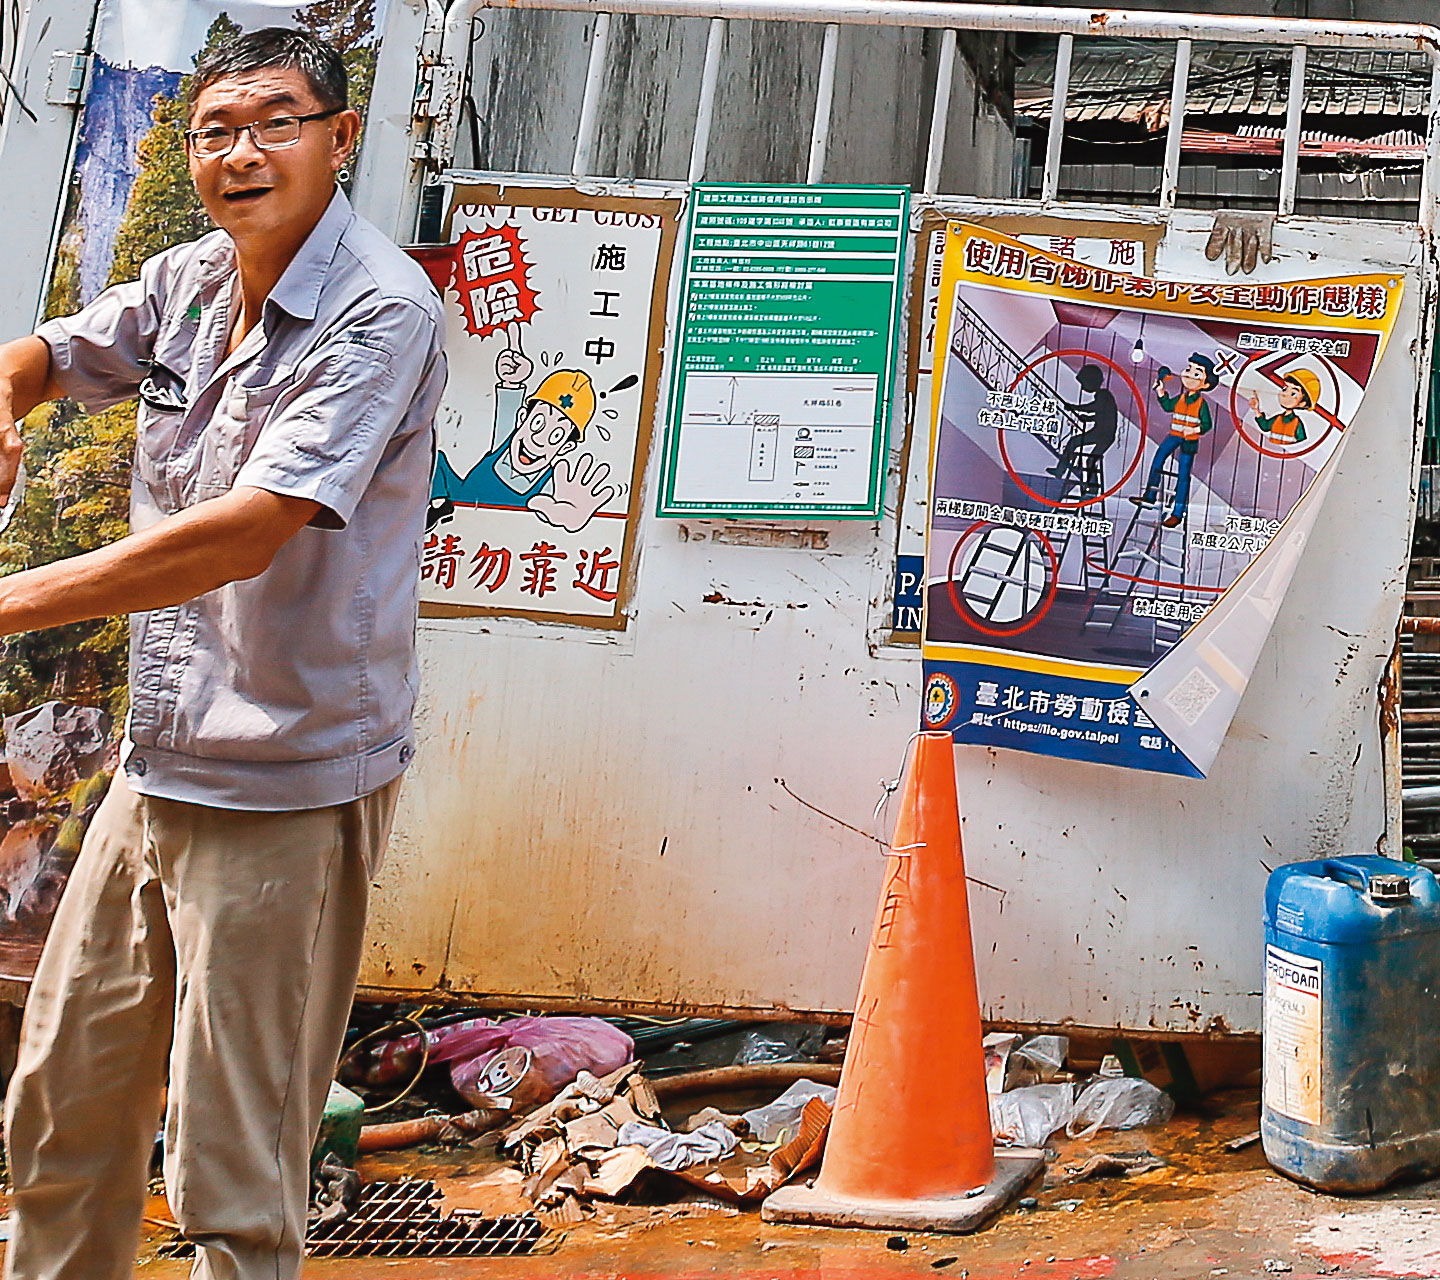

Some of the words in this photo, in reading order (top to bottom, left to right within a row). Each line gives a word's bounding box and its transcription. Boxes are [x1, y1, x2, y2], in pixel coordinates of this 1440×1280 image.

[462, 235, 524, 330] 危險
[584, 243, 626, 368] 施工中
[421, 533, 620, 602] 請勿靠近
[1267, 960, 1319, 990] PROFOAM
